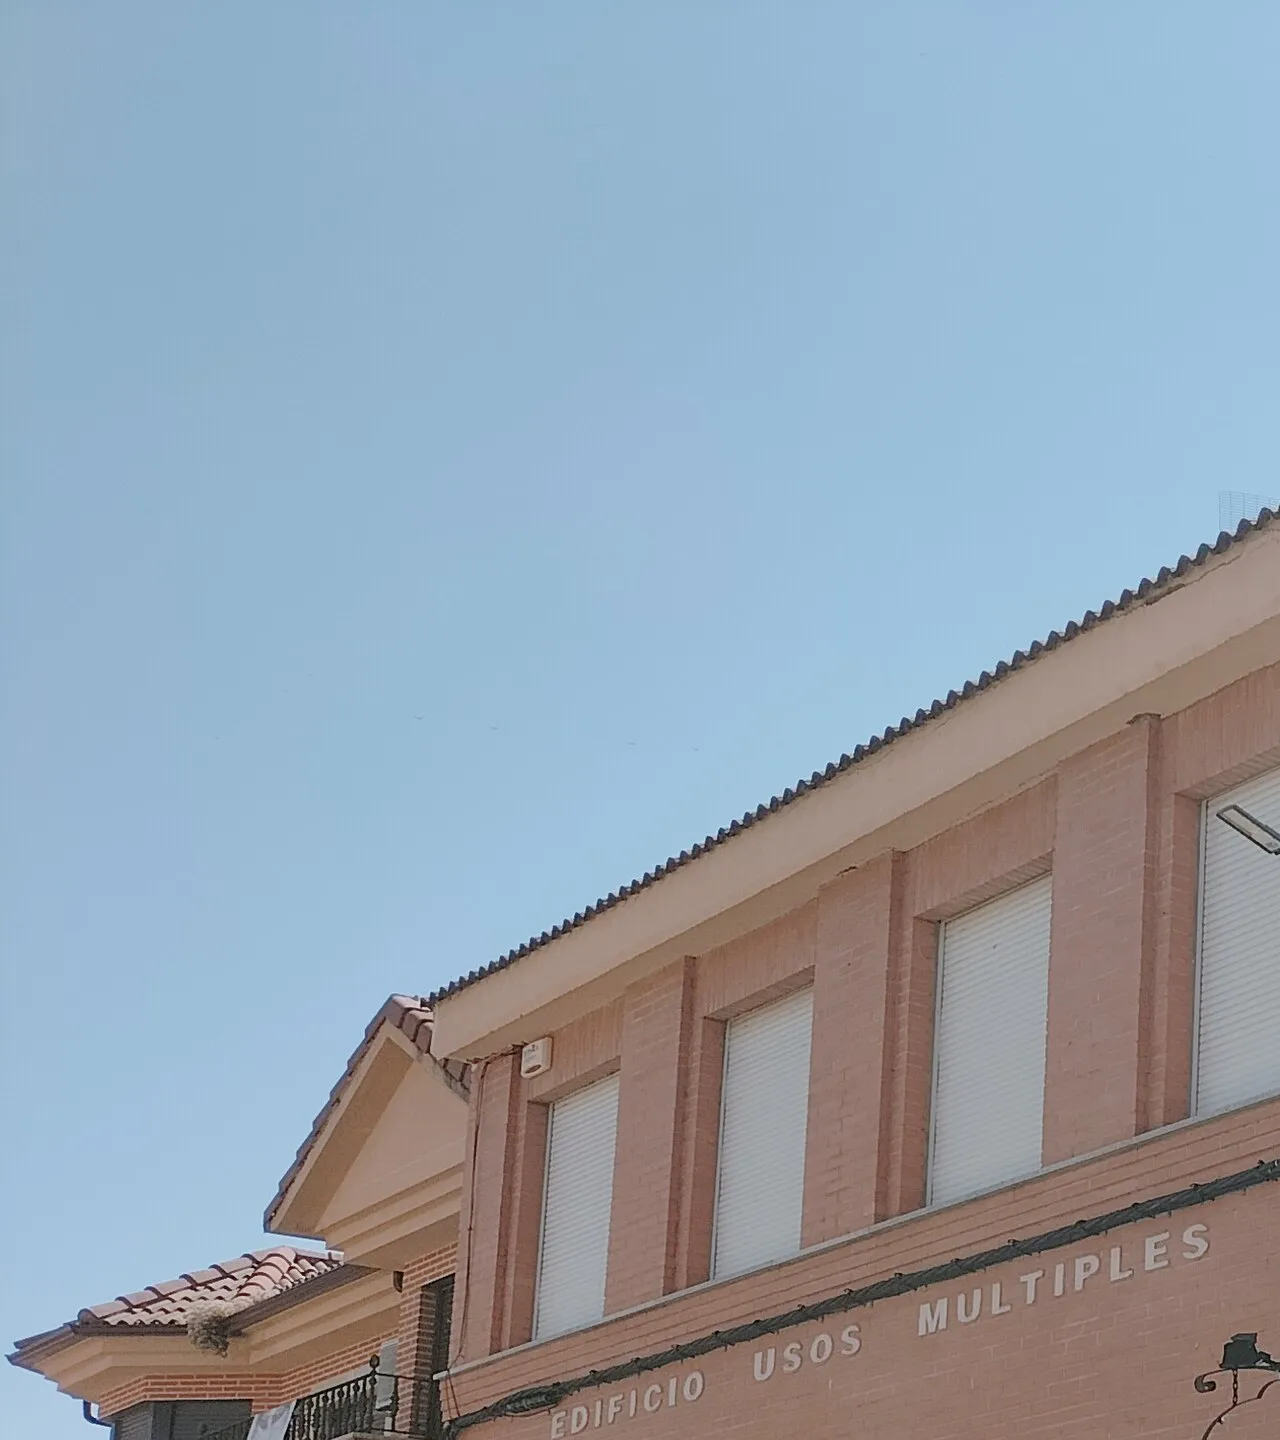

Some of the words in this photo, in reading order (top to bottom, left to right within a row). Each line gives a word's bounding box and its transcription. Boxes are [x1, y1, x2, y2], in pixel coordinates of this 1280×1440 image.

[551, 1370, 705, 1440] EDIFICIO
[753, 1324, 862, 1382] USOS
[917, 1223, 1210, 1337] MULTIPLES
